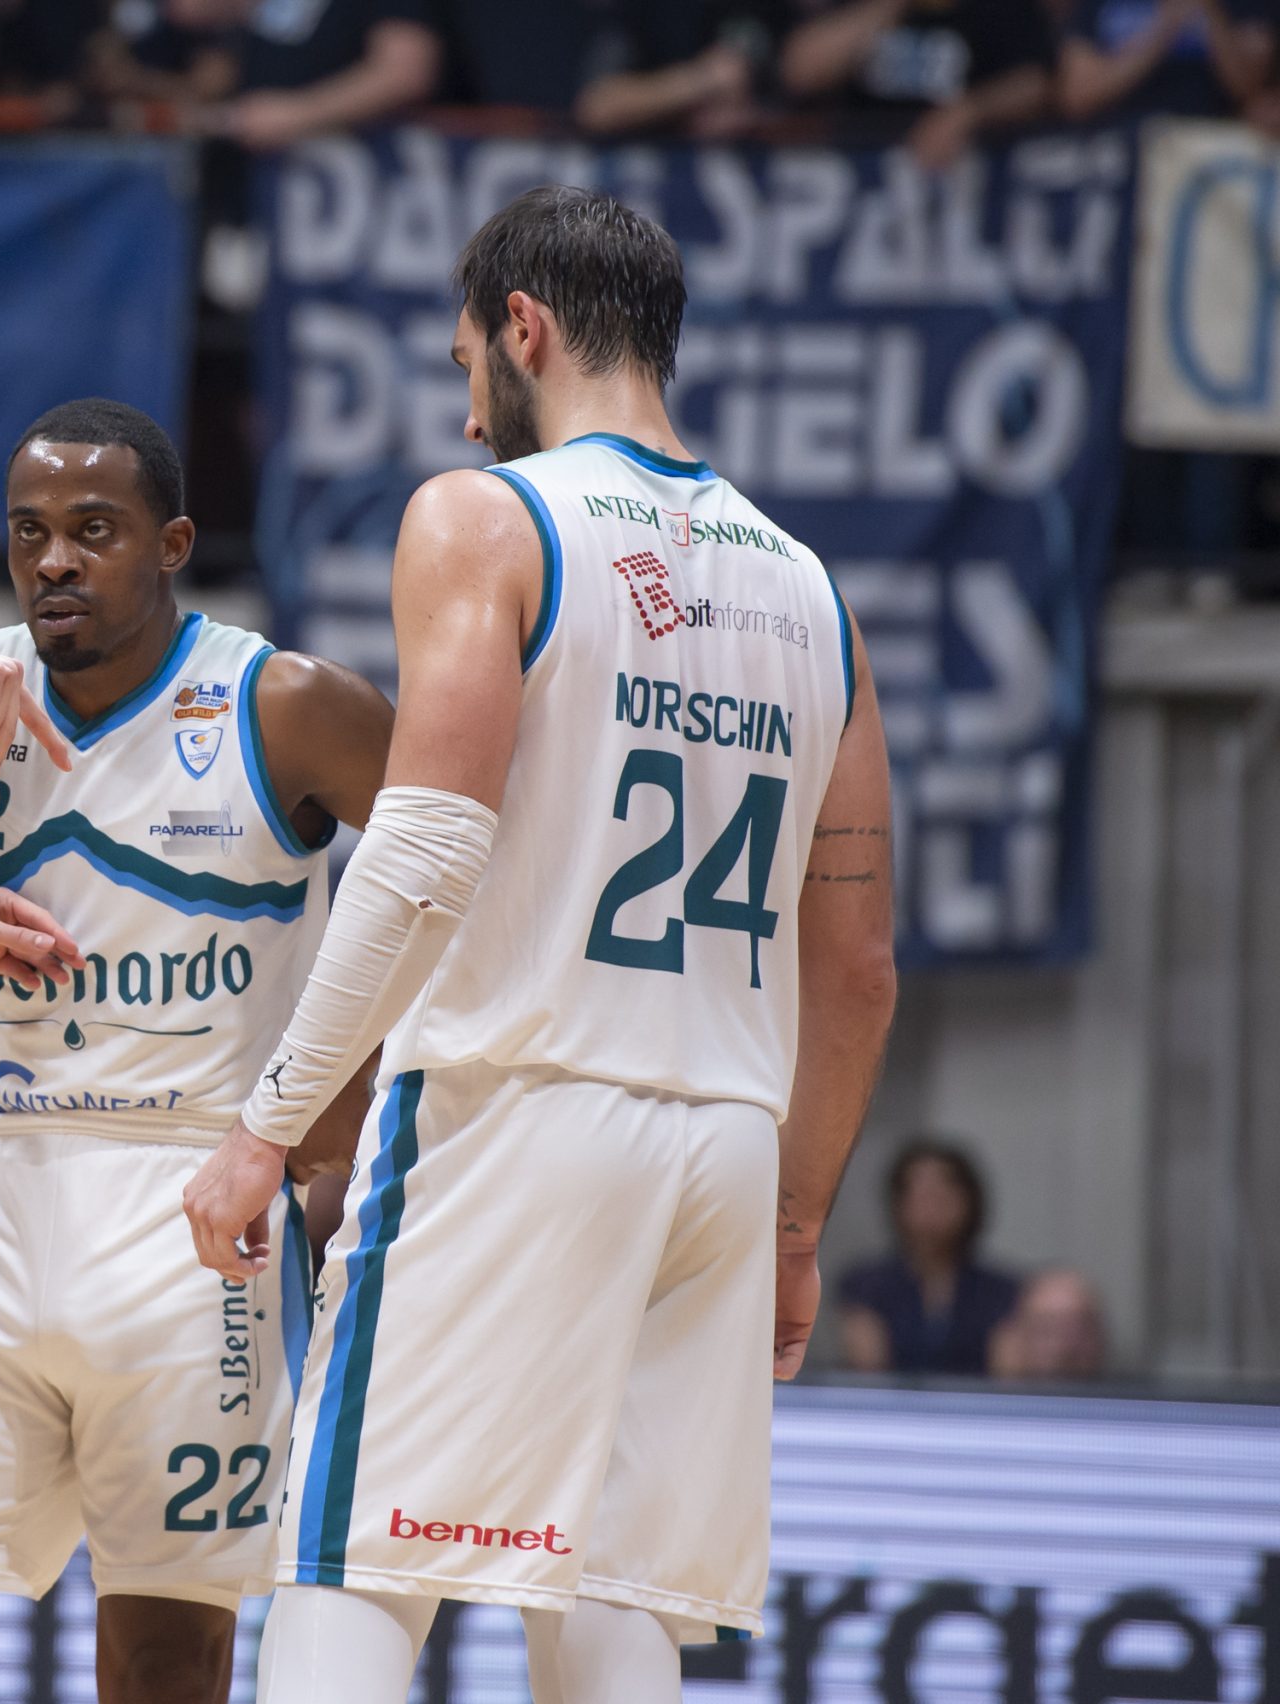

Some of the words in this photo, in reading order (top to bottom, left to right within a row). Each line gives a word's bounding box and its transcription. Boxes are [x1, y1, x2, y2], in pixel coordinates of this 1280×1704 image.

[582, 495, 662, 531] INTESA
[584, 748, 789, 990] 24
[164, 1442, 272, 1532] 22
[389, 1508, 573, 1555] bennet
